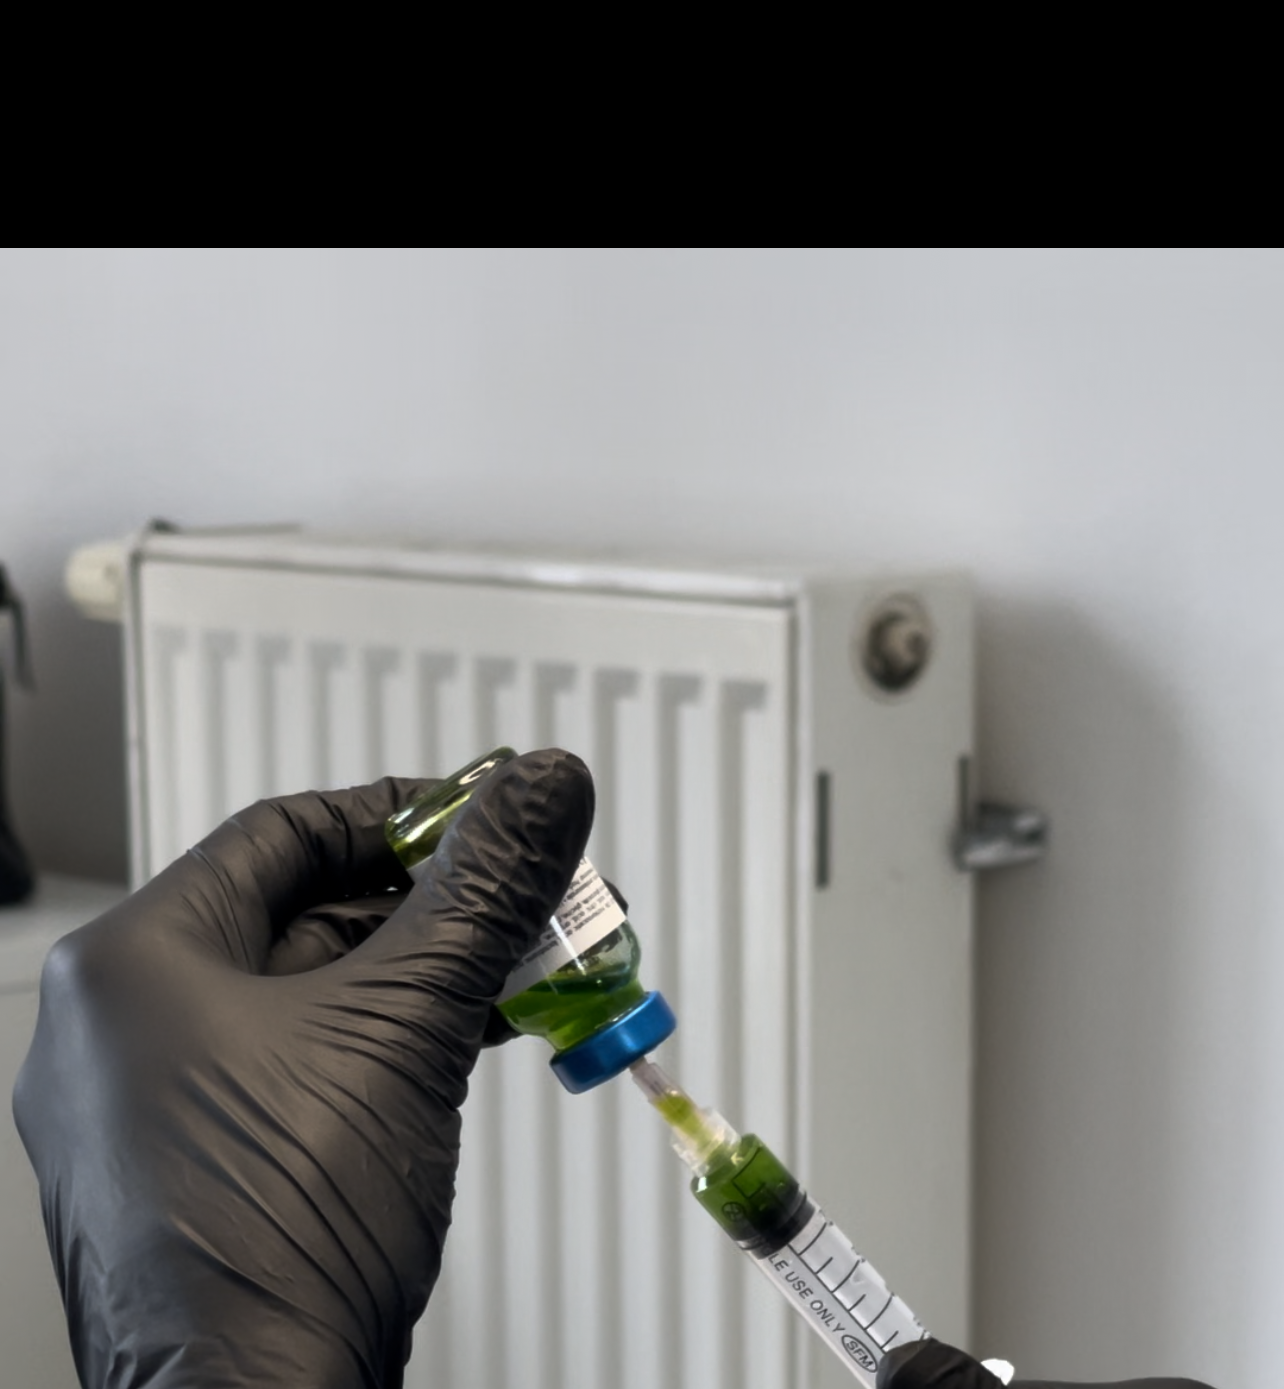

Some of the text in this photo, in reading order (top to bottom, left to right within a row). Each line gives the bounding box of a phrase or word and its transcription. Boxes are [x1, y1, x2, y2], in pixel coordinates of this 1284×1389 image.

[785, 1272, 813, 1300] USE
[810, 1300, 845, 1333] ONLY
[846, 1340, 874, 1368] SFM
